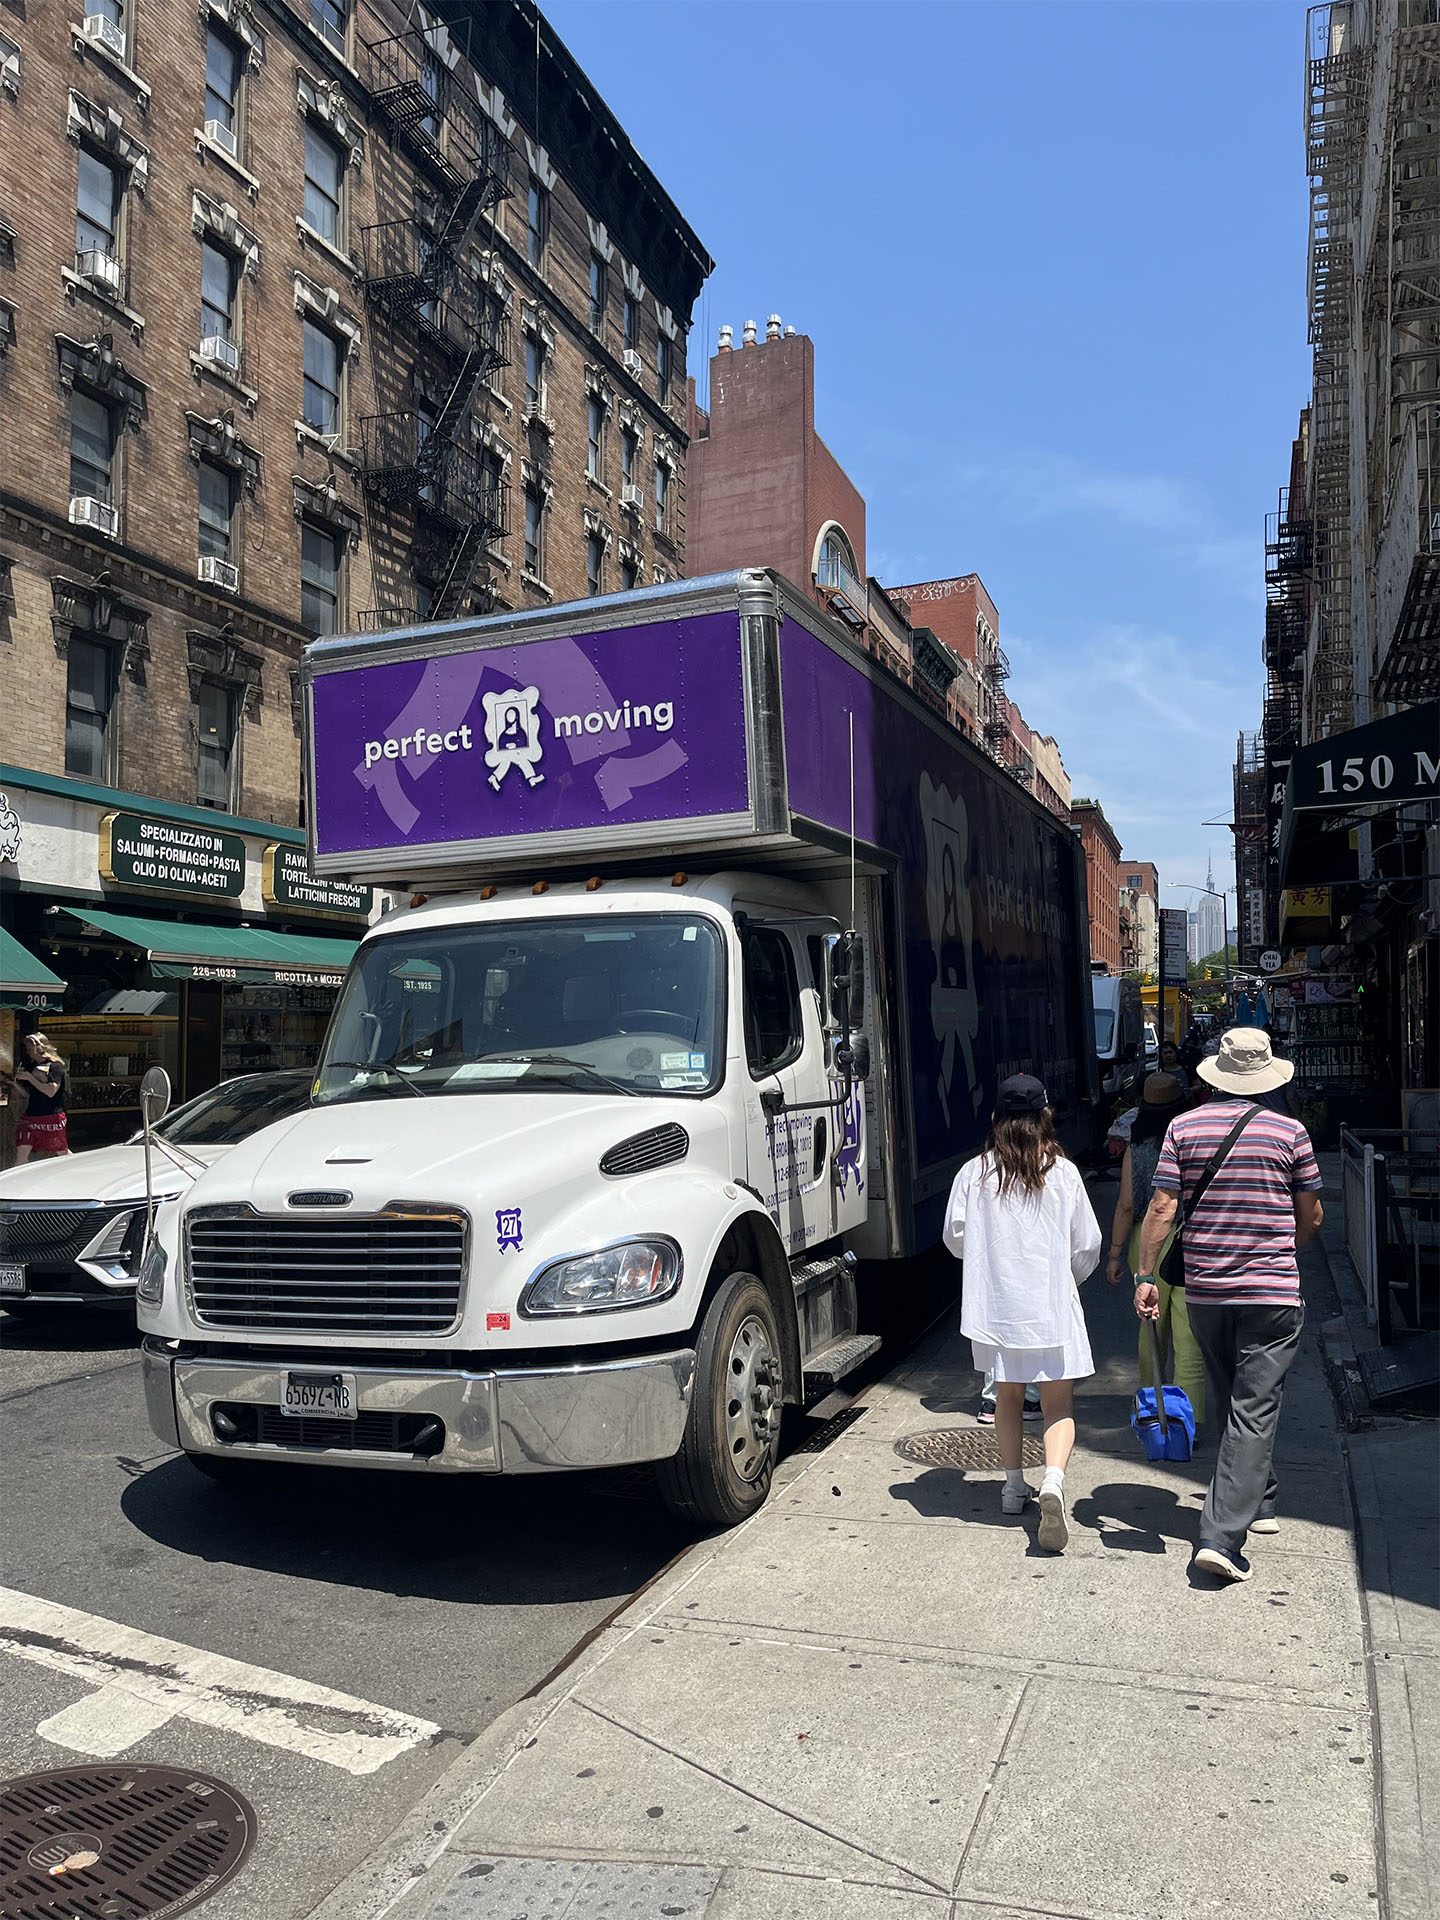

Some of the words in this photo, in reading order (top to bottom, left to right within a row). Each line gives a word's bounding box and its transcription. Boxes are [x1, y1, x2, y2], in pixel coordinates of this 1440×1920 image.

[364, 723, 472, 769] perfect
[554, 699, 675, 739] moving
[1316, 754, 1394, 794] 150
[140, 824, 212, 851] SPECIALIZZATO
[213, 838, 222, 852] IN
[117, 839, 154, 858] SALUMI
[159, 847, 209, 868] FORMAGGI
[213, 858, 241, 873] PASTA
[132, 861, 156, 878] OLIO
[158, 865, 168, 879] DI
[170, 867, 197, 884] OLIVA
[201, 873, 227, 889] ACETI
[288, 886, 328, 904] LATTICINI
[328, 893, 361, 909] FRESCHI
[192, 966, 237, 978] 226-1033
[275, 971, 313, 984] RICOTTA
[417, 981, 432, 990] 1925
[27, 994, 47, 1007] 200
[503, 1216, 516, 1236] 27
[301, 1408, 337, 1416] COMMERCIAL
